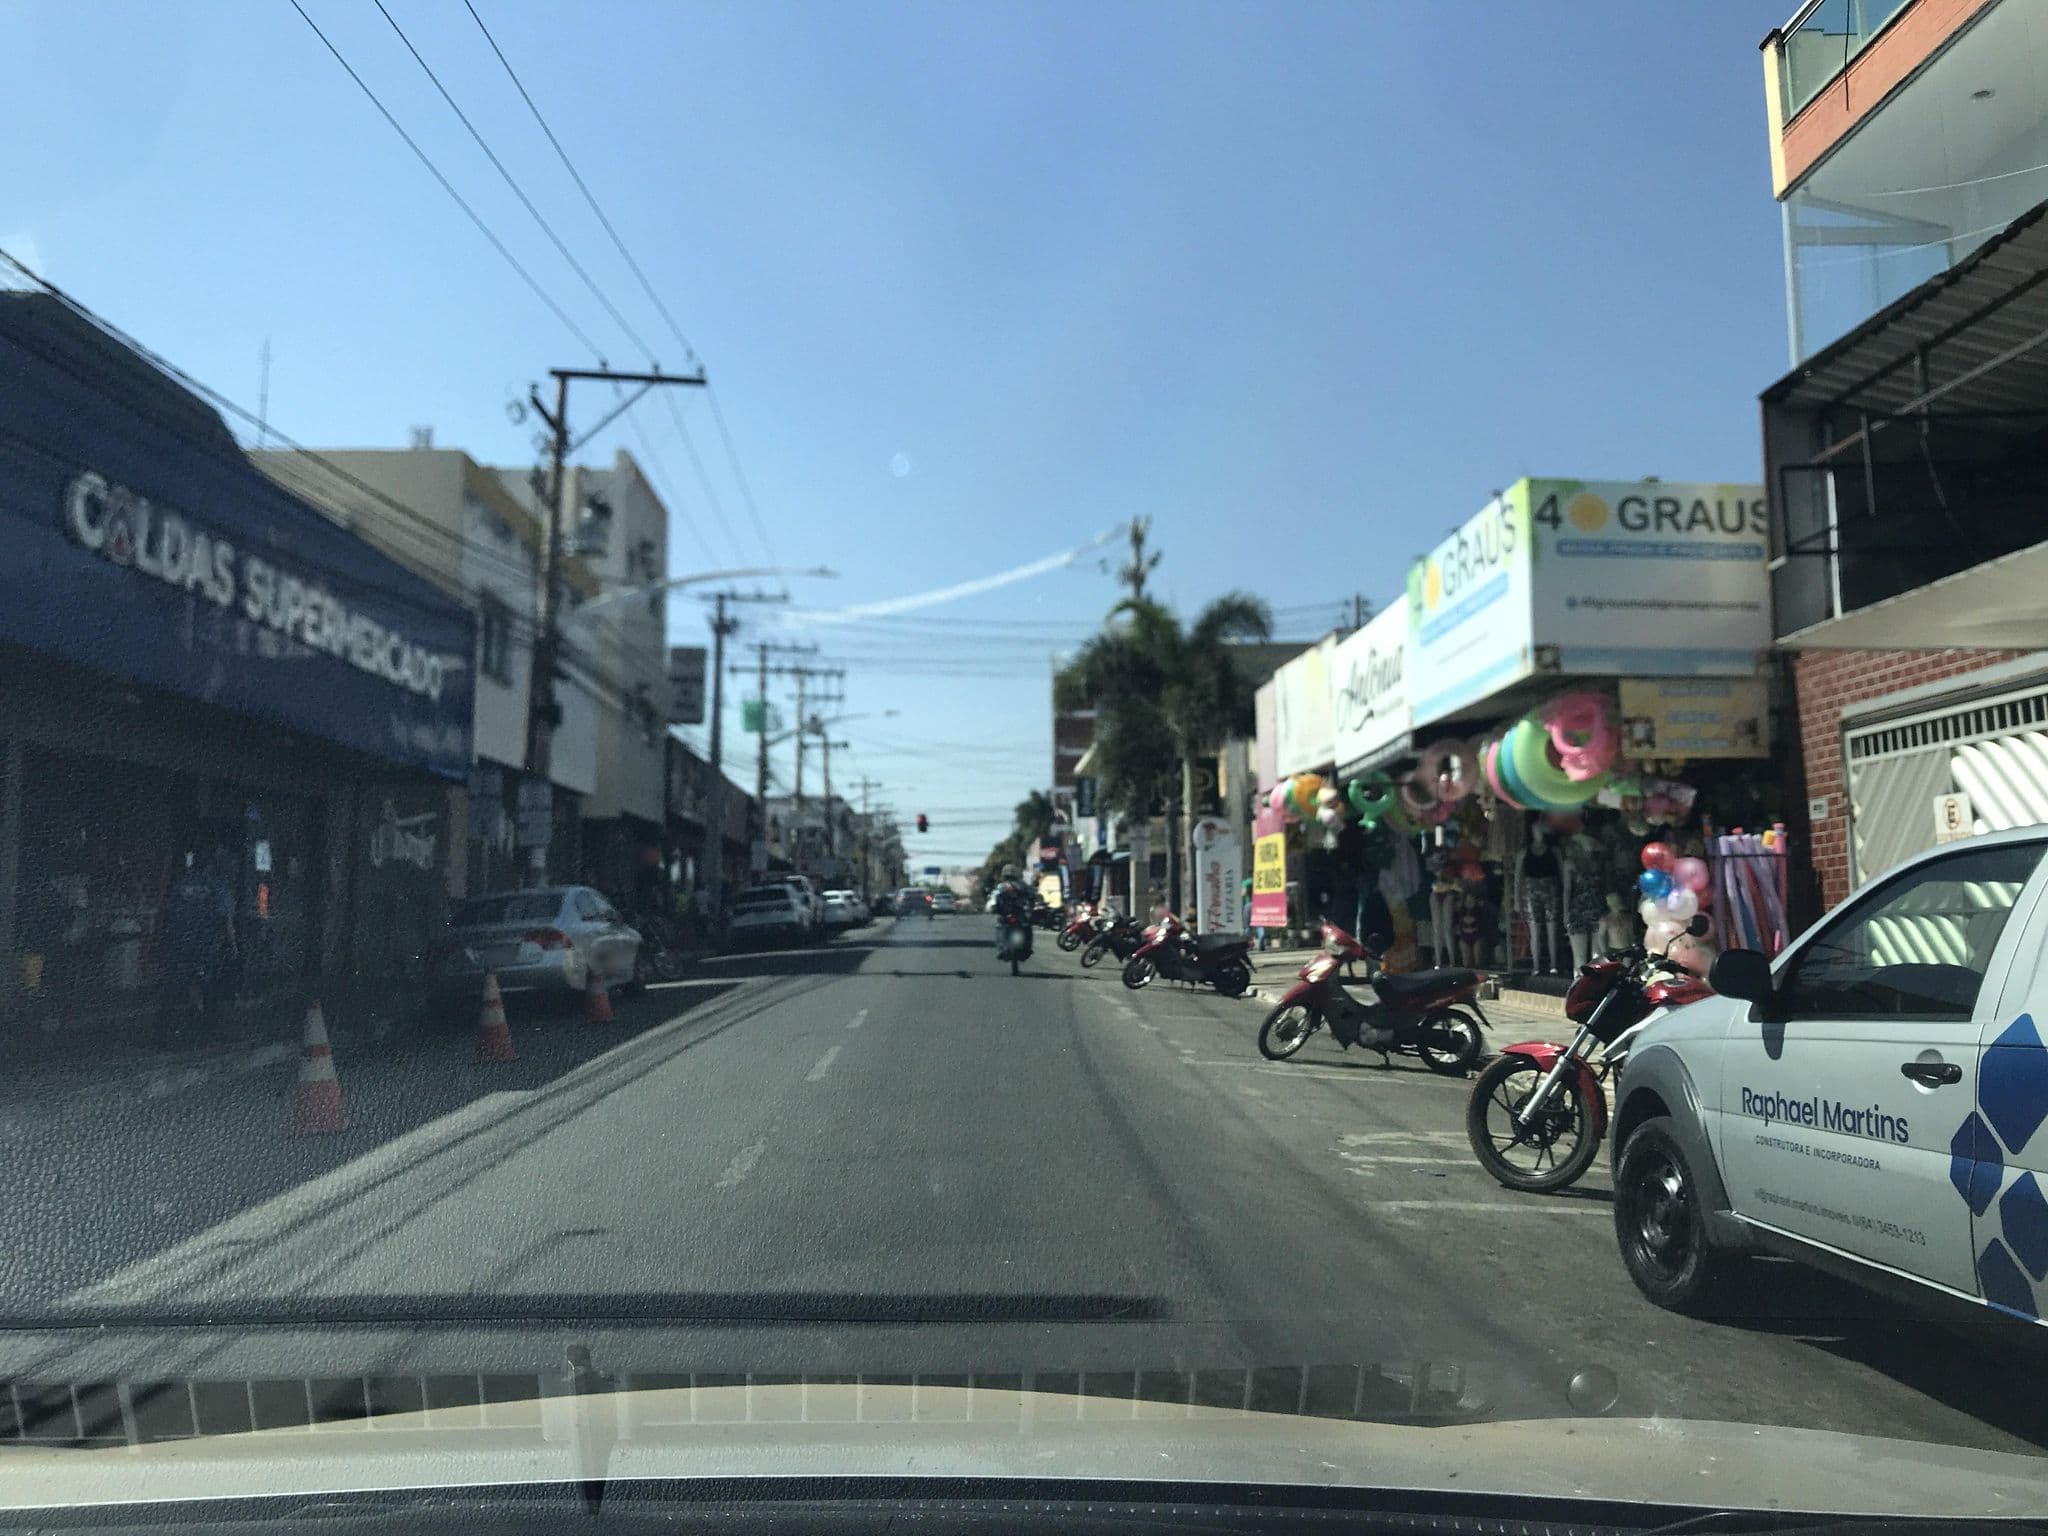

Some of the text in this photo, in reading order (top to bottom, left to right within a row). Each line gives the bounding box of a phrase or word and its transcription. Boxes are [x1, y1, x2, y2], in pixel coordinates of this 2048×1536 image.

[1617, 495, 1769, 535] GRAUS
[1441, 502, 1515, 597] GRAUS
[1742, 1086, 1910, 1143] Raphael Martins
[1755, 1134, 1881, 1170] CONSTRUTORA E INCORPORADORA
